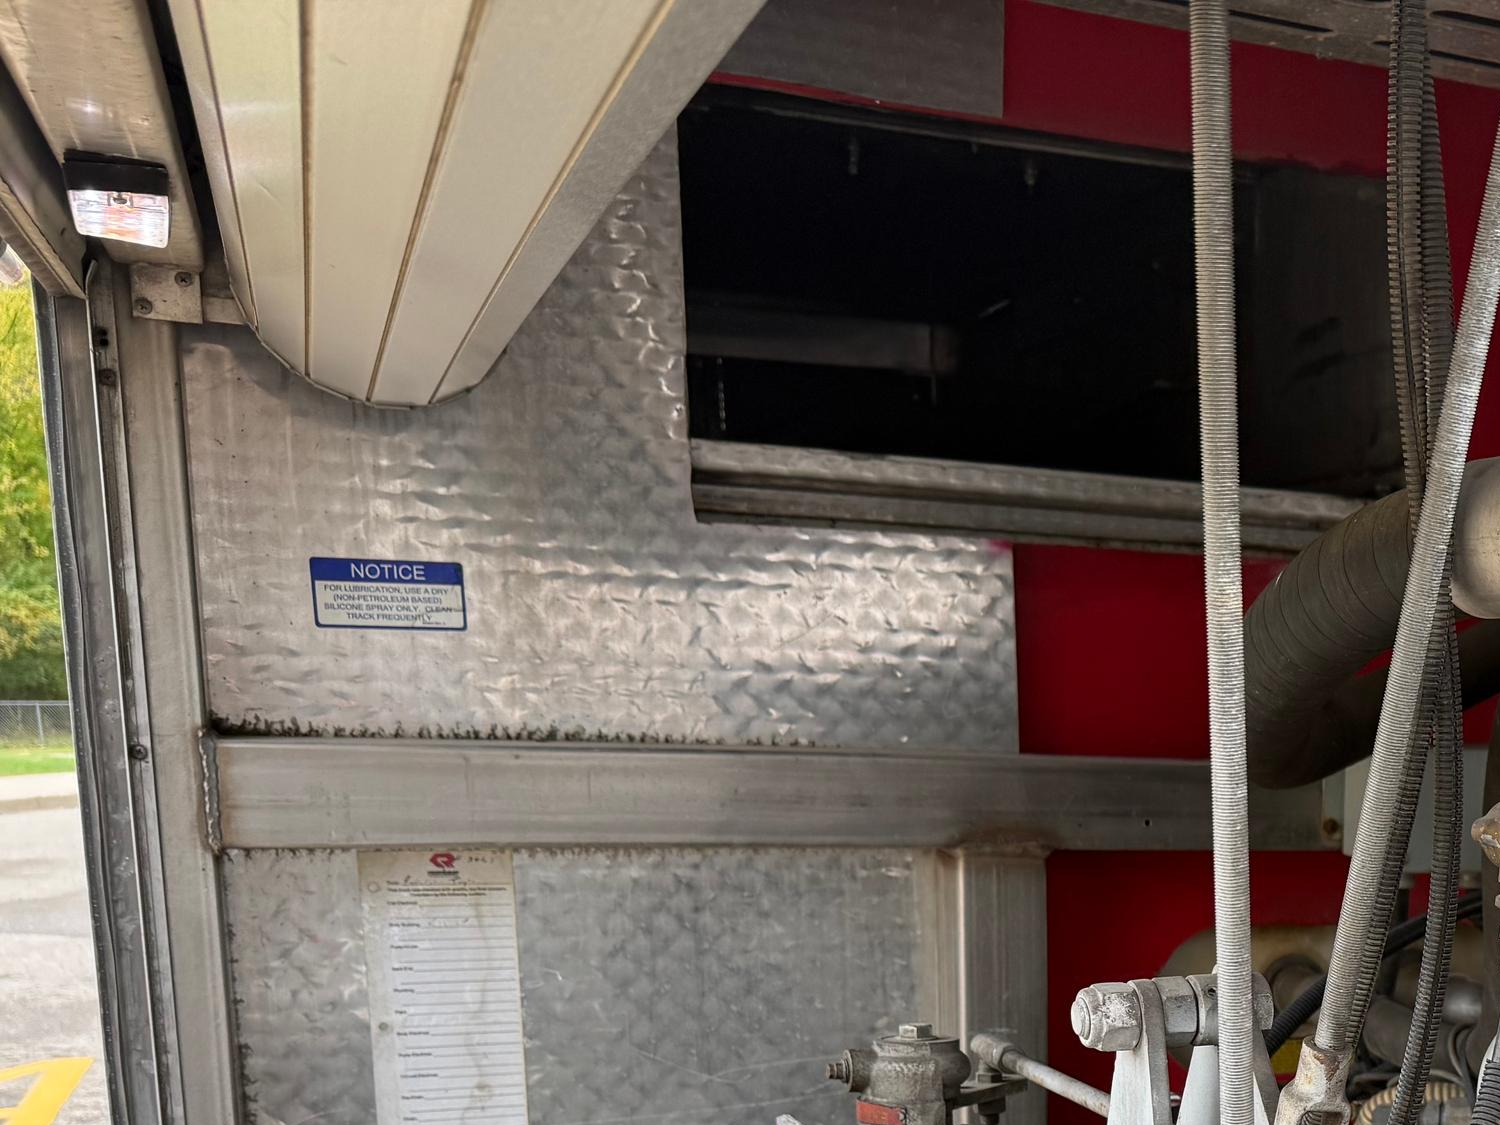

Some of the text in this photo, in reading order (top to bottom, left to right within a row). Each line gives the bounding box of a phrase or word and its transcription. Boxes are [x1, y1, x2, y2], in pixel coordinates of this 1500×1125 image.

[350, 562, 426, 581] NOTICE
[323, 584, 343, 592] FOR
[405, 587, 421, 595] USE
[431, 588, 449, 596] DRY
[411, 596, 443, 605] BASED)
[324, 603, 364, 611] SILICONE
[366, 604, 394, 612] SPRAY
[346, 612, 433, 622] TRACK FREQUENTLY
